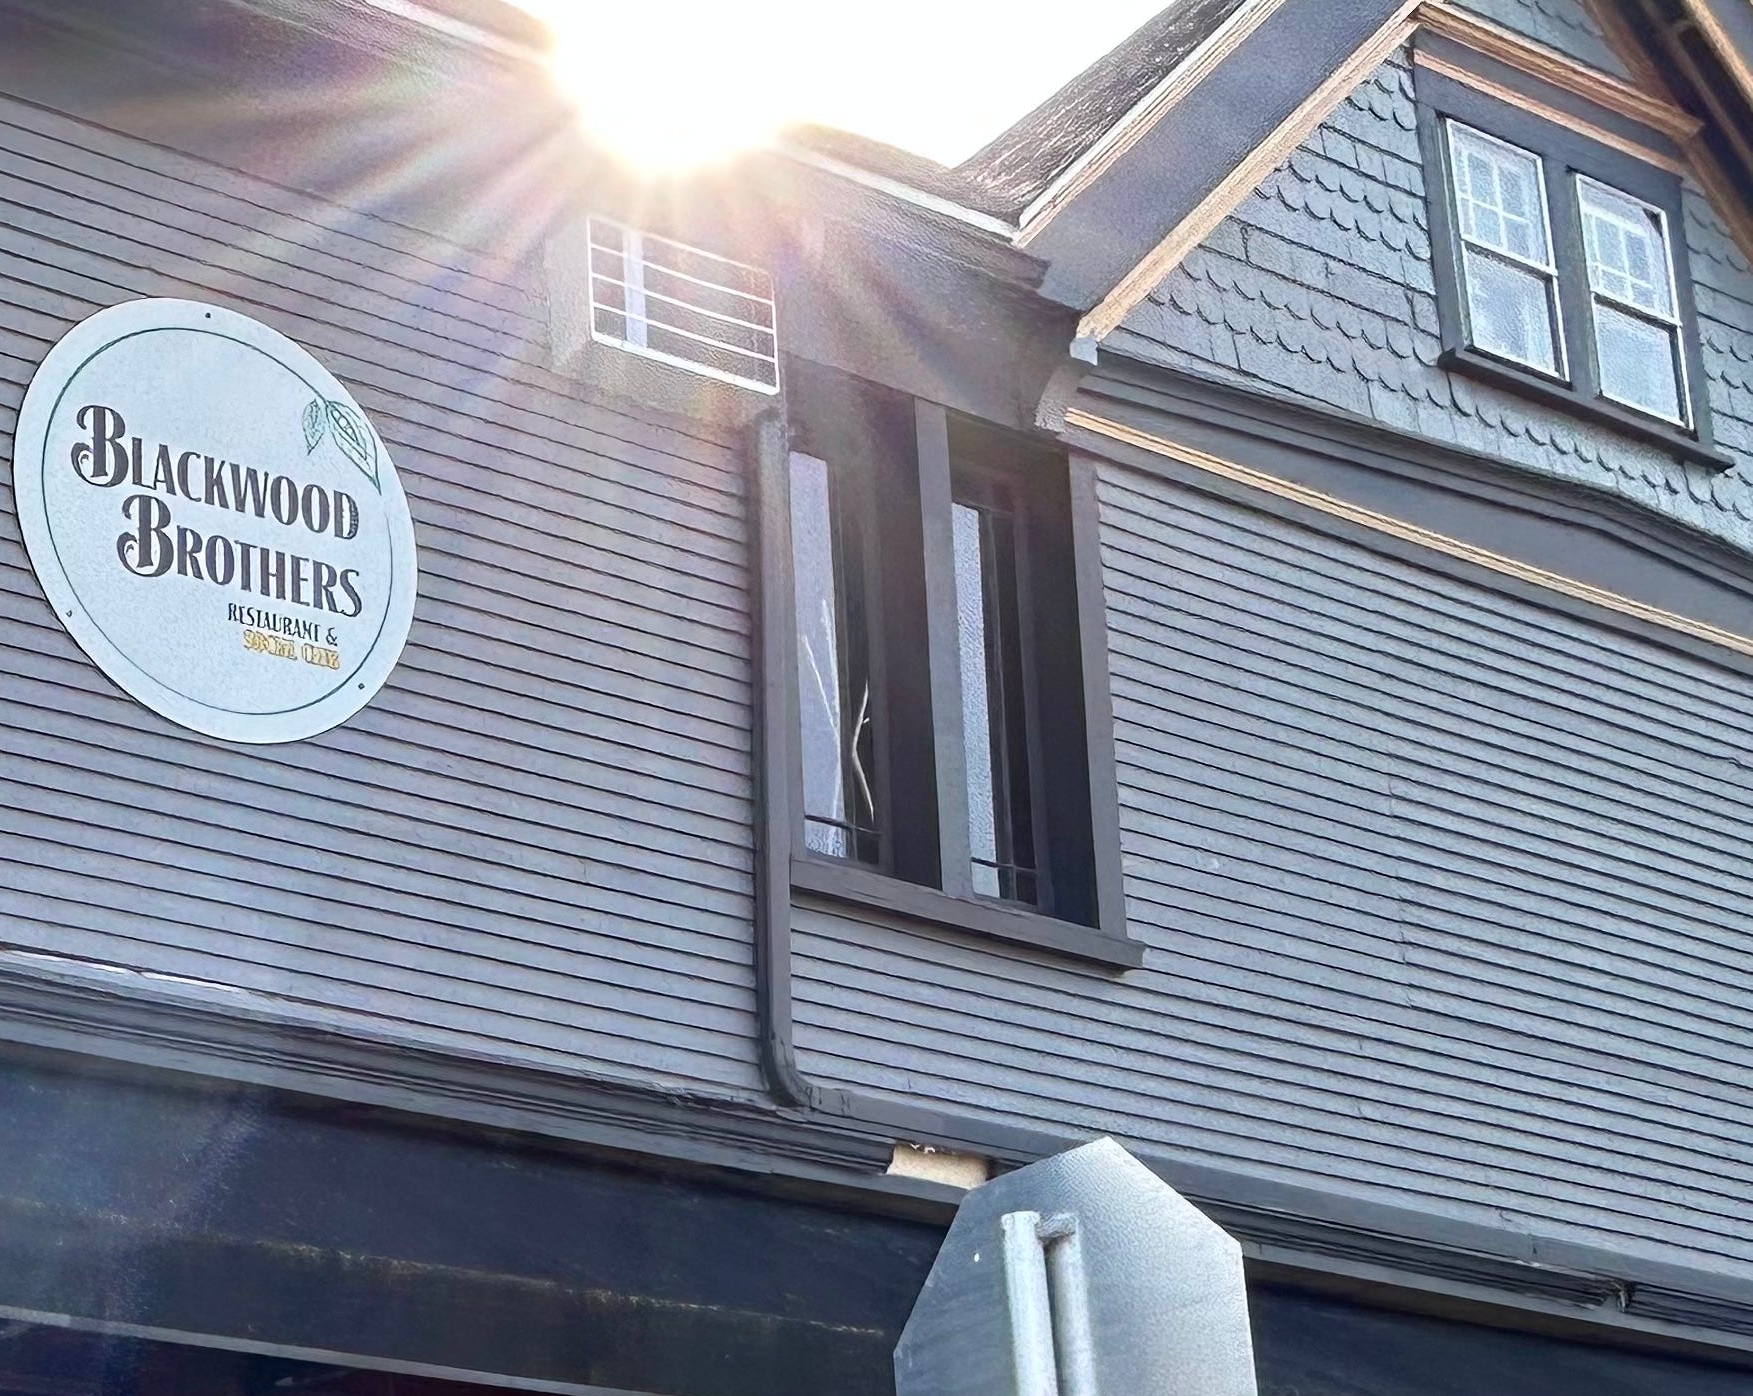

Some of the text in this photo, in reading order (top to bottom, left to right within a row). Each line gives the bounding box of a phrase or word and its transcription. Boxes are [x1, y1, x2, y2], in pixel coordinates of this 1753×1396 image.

[70, 405, 360, 540] BLACKWOOD
[116, 494, 362, 618] BROTHERS
[228, 602, 339, 647] RESTAURANT &
